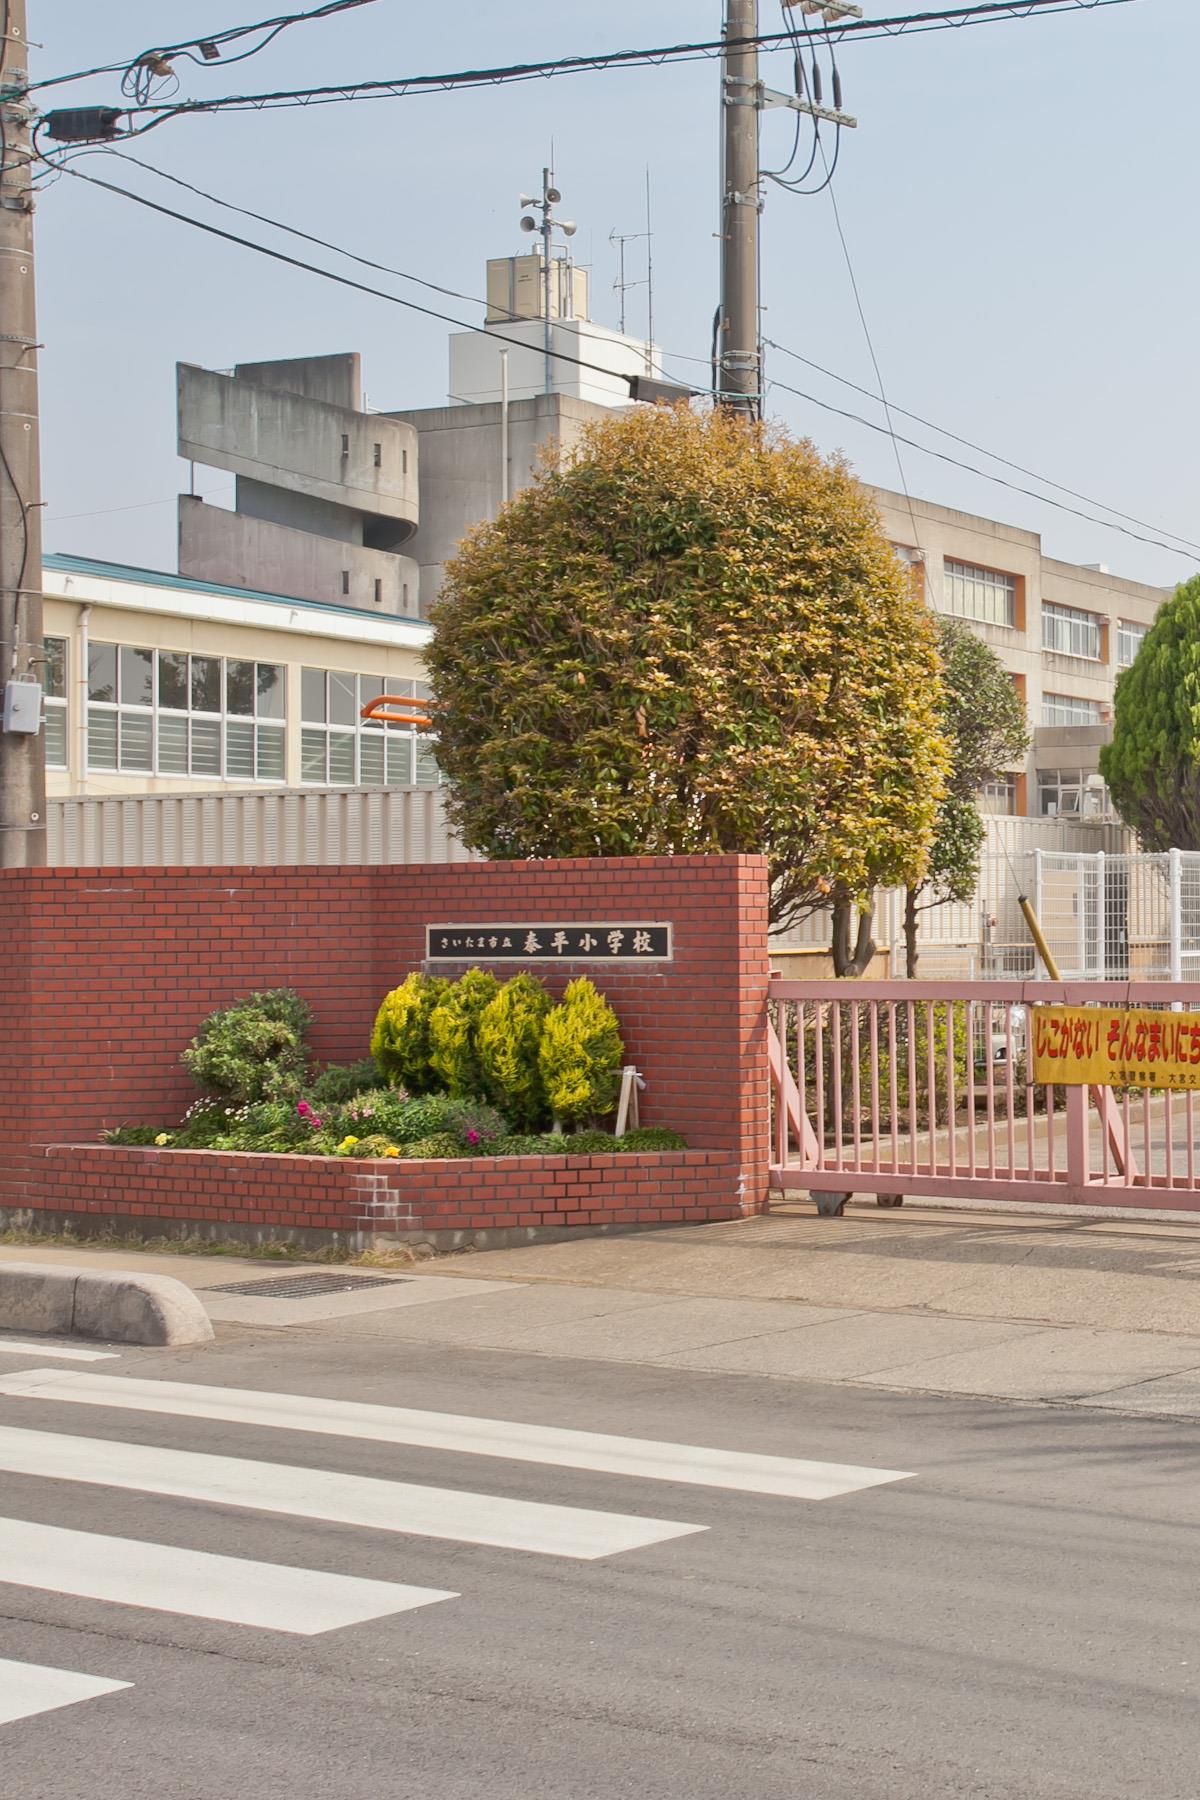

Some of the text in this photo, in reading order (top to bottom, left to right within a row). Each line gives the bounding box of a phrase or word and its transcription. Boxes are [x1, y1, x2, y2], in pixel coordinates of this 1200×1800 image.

[440, 930, 655, 954] さいたま市立 泰平小学校
[1037, 1016, 1098, 1059] じこがない
